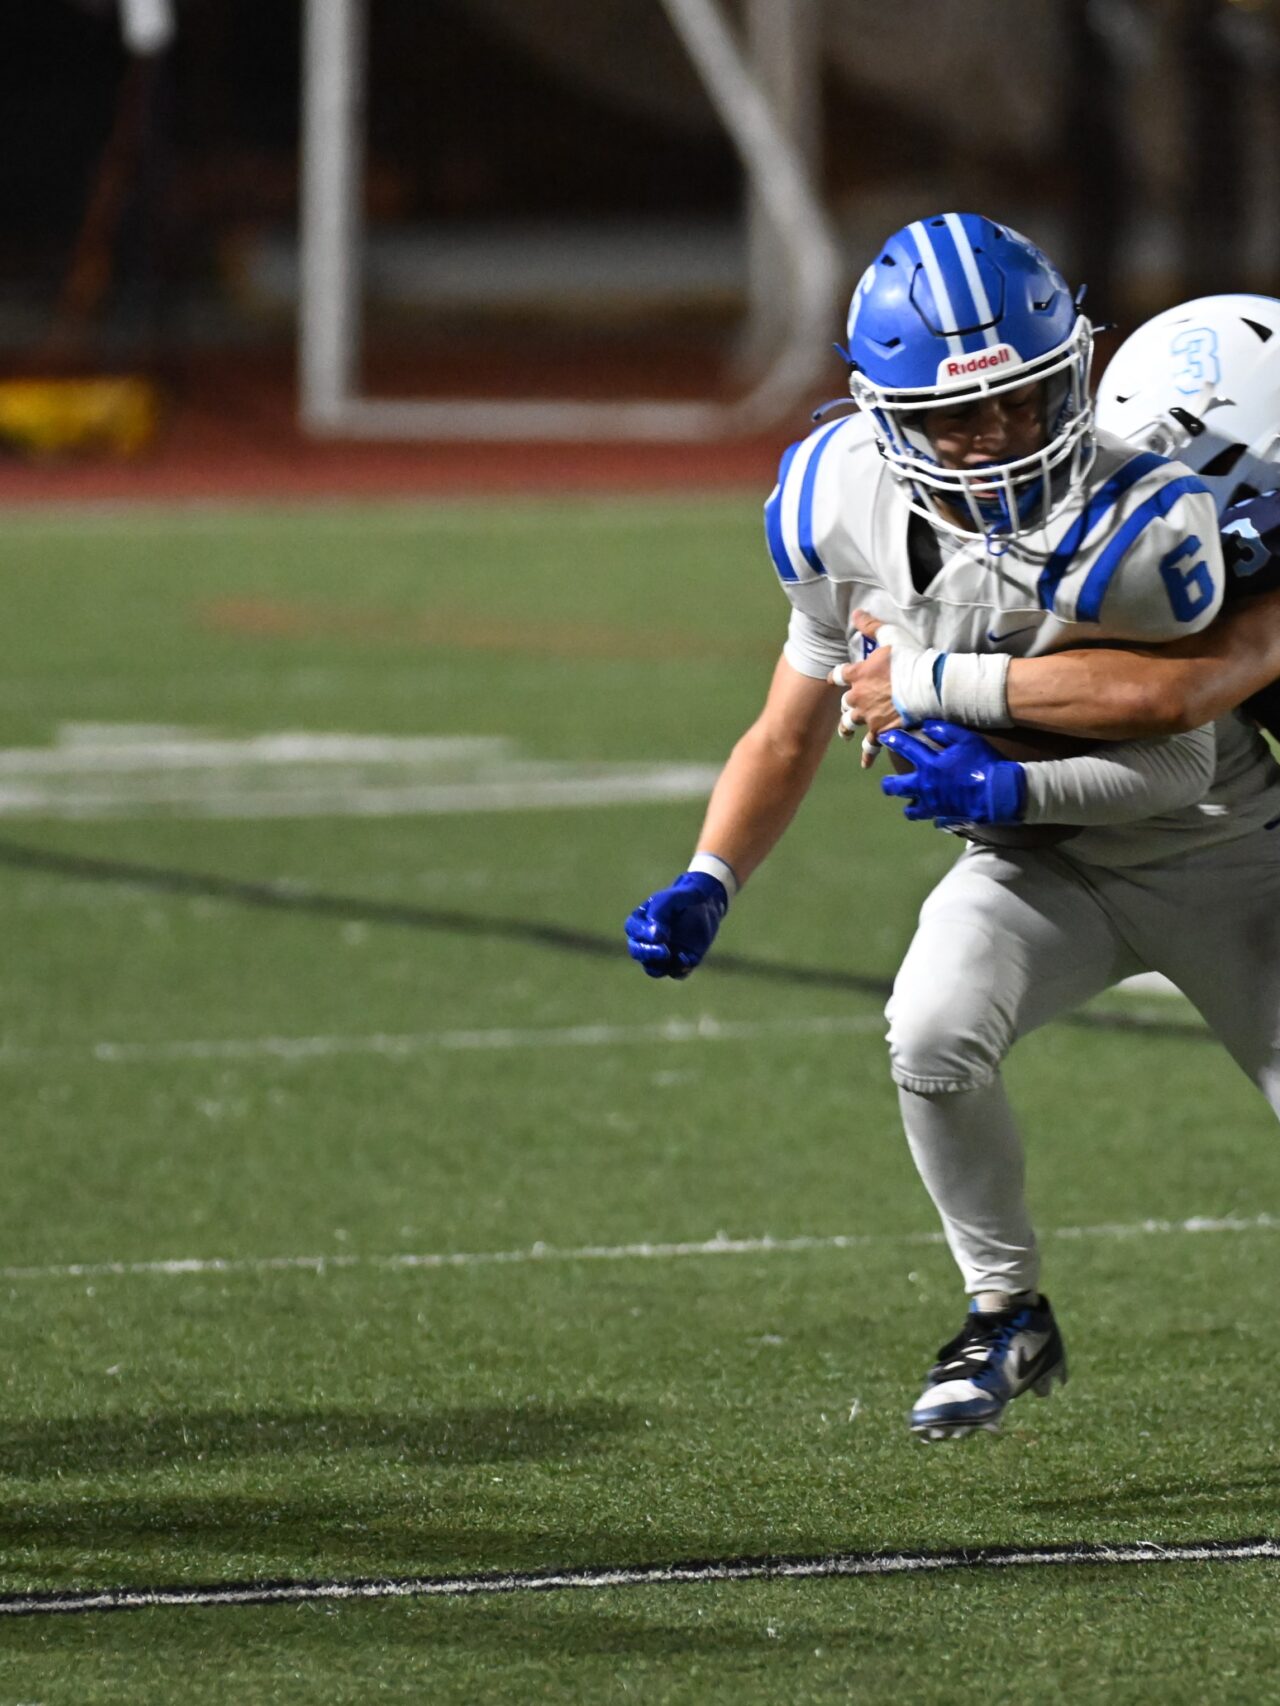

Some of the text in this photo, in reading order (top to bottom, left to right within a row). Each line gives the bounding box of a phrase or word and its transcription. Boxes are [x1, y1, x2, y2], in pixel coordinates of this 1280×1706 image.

[947, 348, 1010, 377] Riddell
[1170, 327, 1222, 395] 3
[1159, 534, 1214, 623] 6
[1220, 517, 1272, 578] 3
